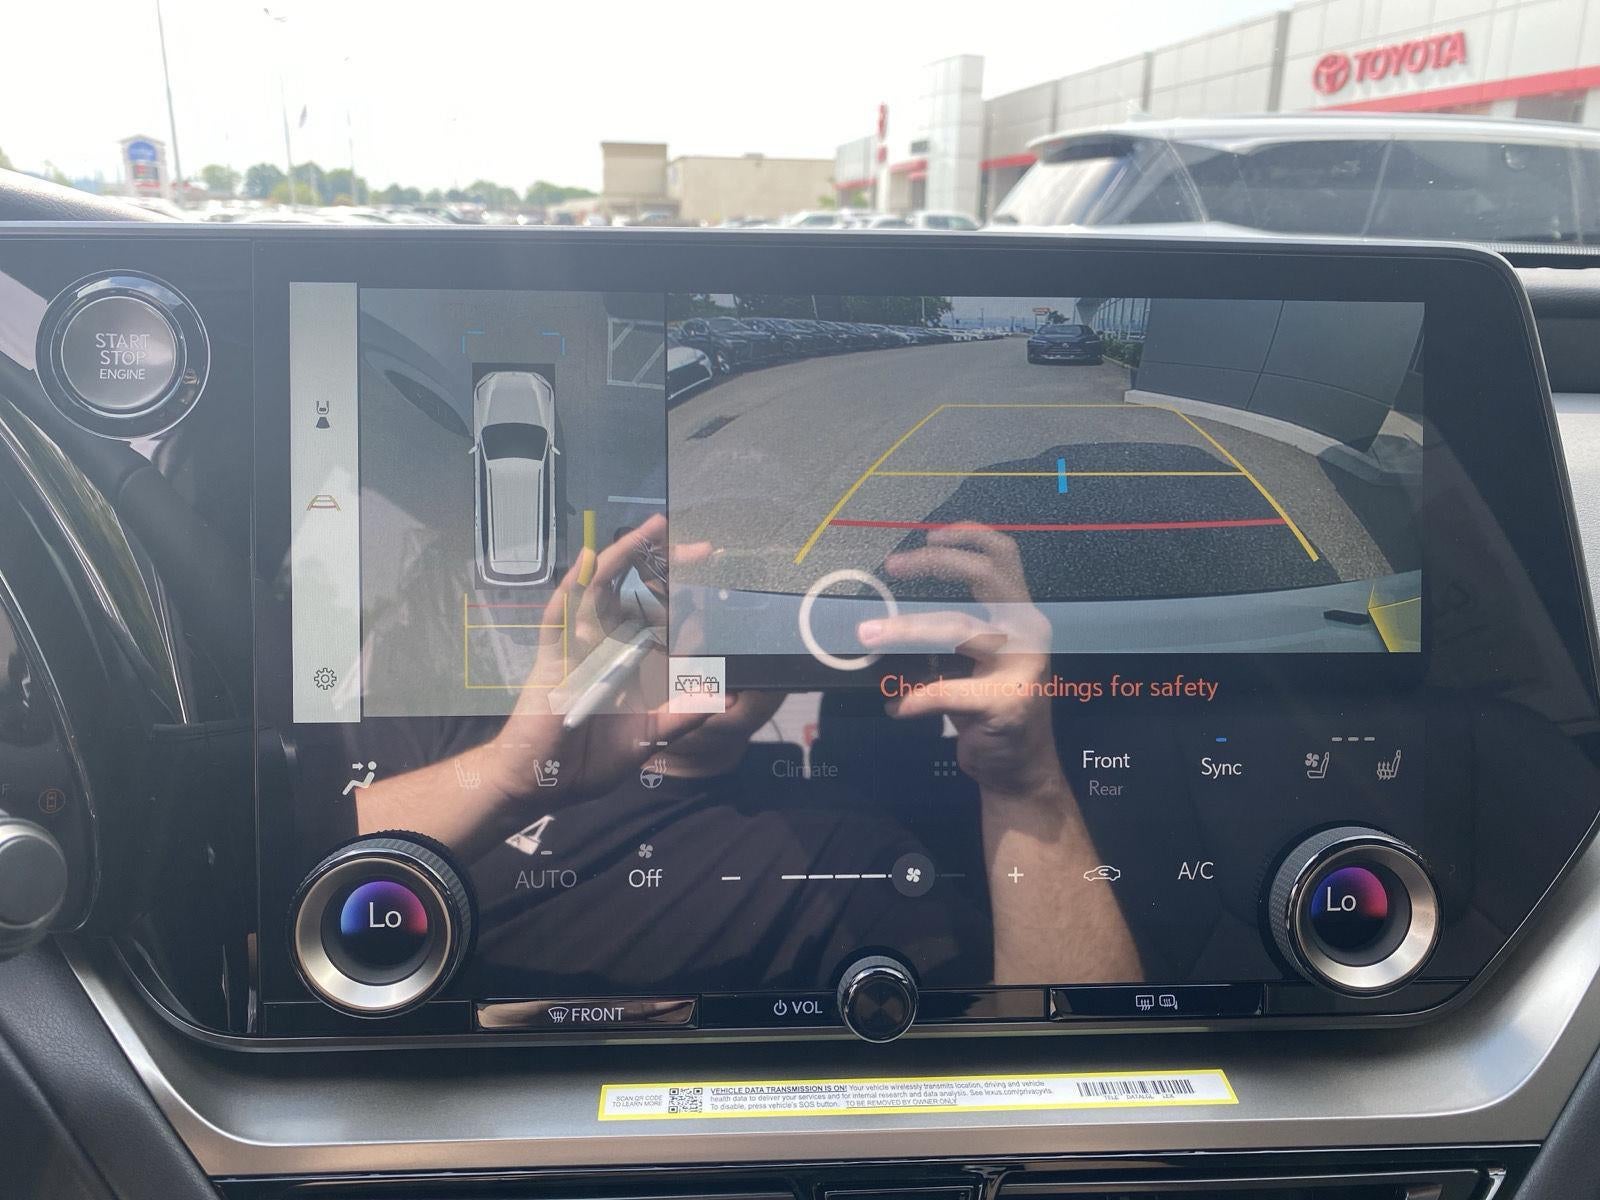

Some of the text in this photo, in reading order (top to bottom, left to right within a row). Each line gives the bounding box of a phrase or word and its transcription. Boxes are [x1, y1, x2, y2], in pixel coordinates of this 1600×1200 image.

[1354, 31, 1466, 82] TOYOTA
[95, 333, 151, 349] START
[100, 349, 146, 366] STOP
[100, 368, 146, 380] ENGINE
[880, 674, 1219, 703] Check surroundings for safety
[772, 759, 839, 778] Climate
[1082, 750, 1131, 769] Front
[1201, 757, 1243, 779] Sync
[1089, 779, 1124, 796] Rear
[514, 869, 577, 889] AUTO
[628, 868, 663, 888] Off
[1177, 861, 1214, 880] A/C
[1327, 886, 1357, 912] Lo
[369, 901, 402, 928] Lo
[571, 1007, 625, 1022] FRONT
[792, 1001, 823, 1014] VOL
[710, 1087, 743, 1095] VEHICLE
[745, 1086, 764, 1094] DATA
[766, 1085, 823, 1093] TRANSMISSION
[824, 1084, 832, 1092] IS
[834, 1084, 847, 1092] ON!
[891, 1083, 922, 1091] wirelessly
[923, 1082, 954, 1090] transmits
[710, 1095, 730, 1103] health
[828, 1092, 840, 1100] and
[852, 1091, 878, 1099] internal
[878, 1091, 908, 1099] research
[909, 1090, 923, 1098] and
[748, 1103, 767, 1111] press
[798, 1101, 815, 1109] SOS
